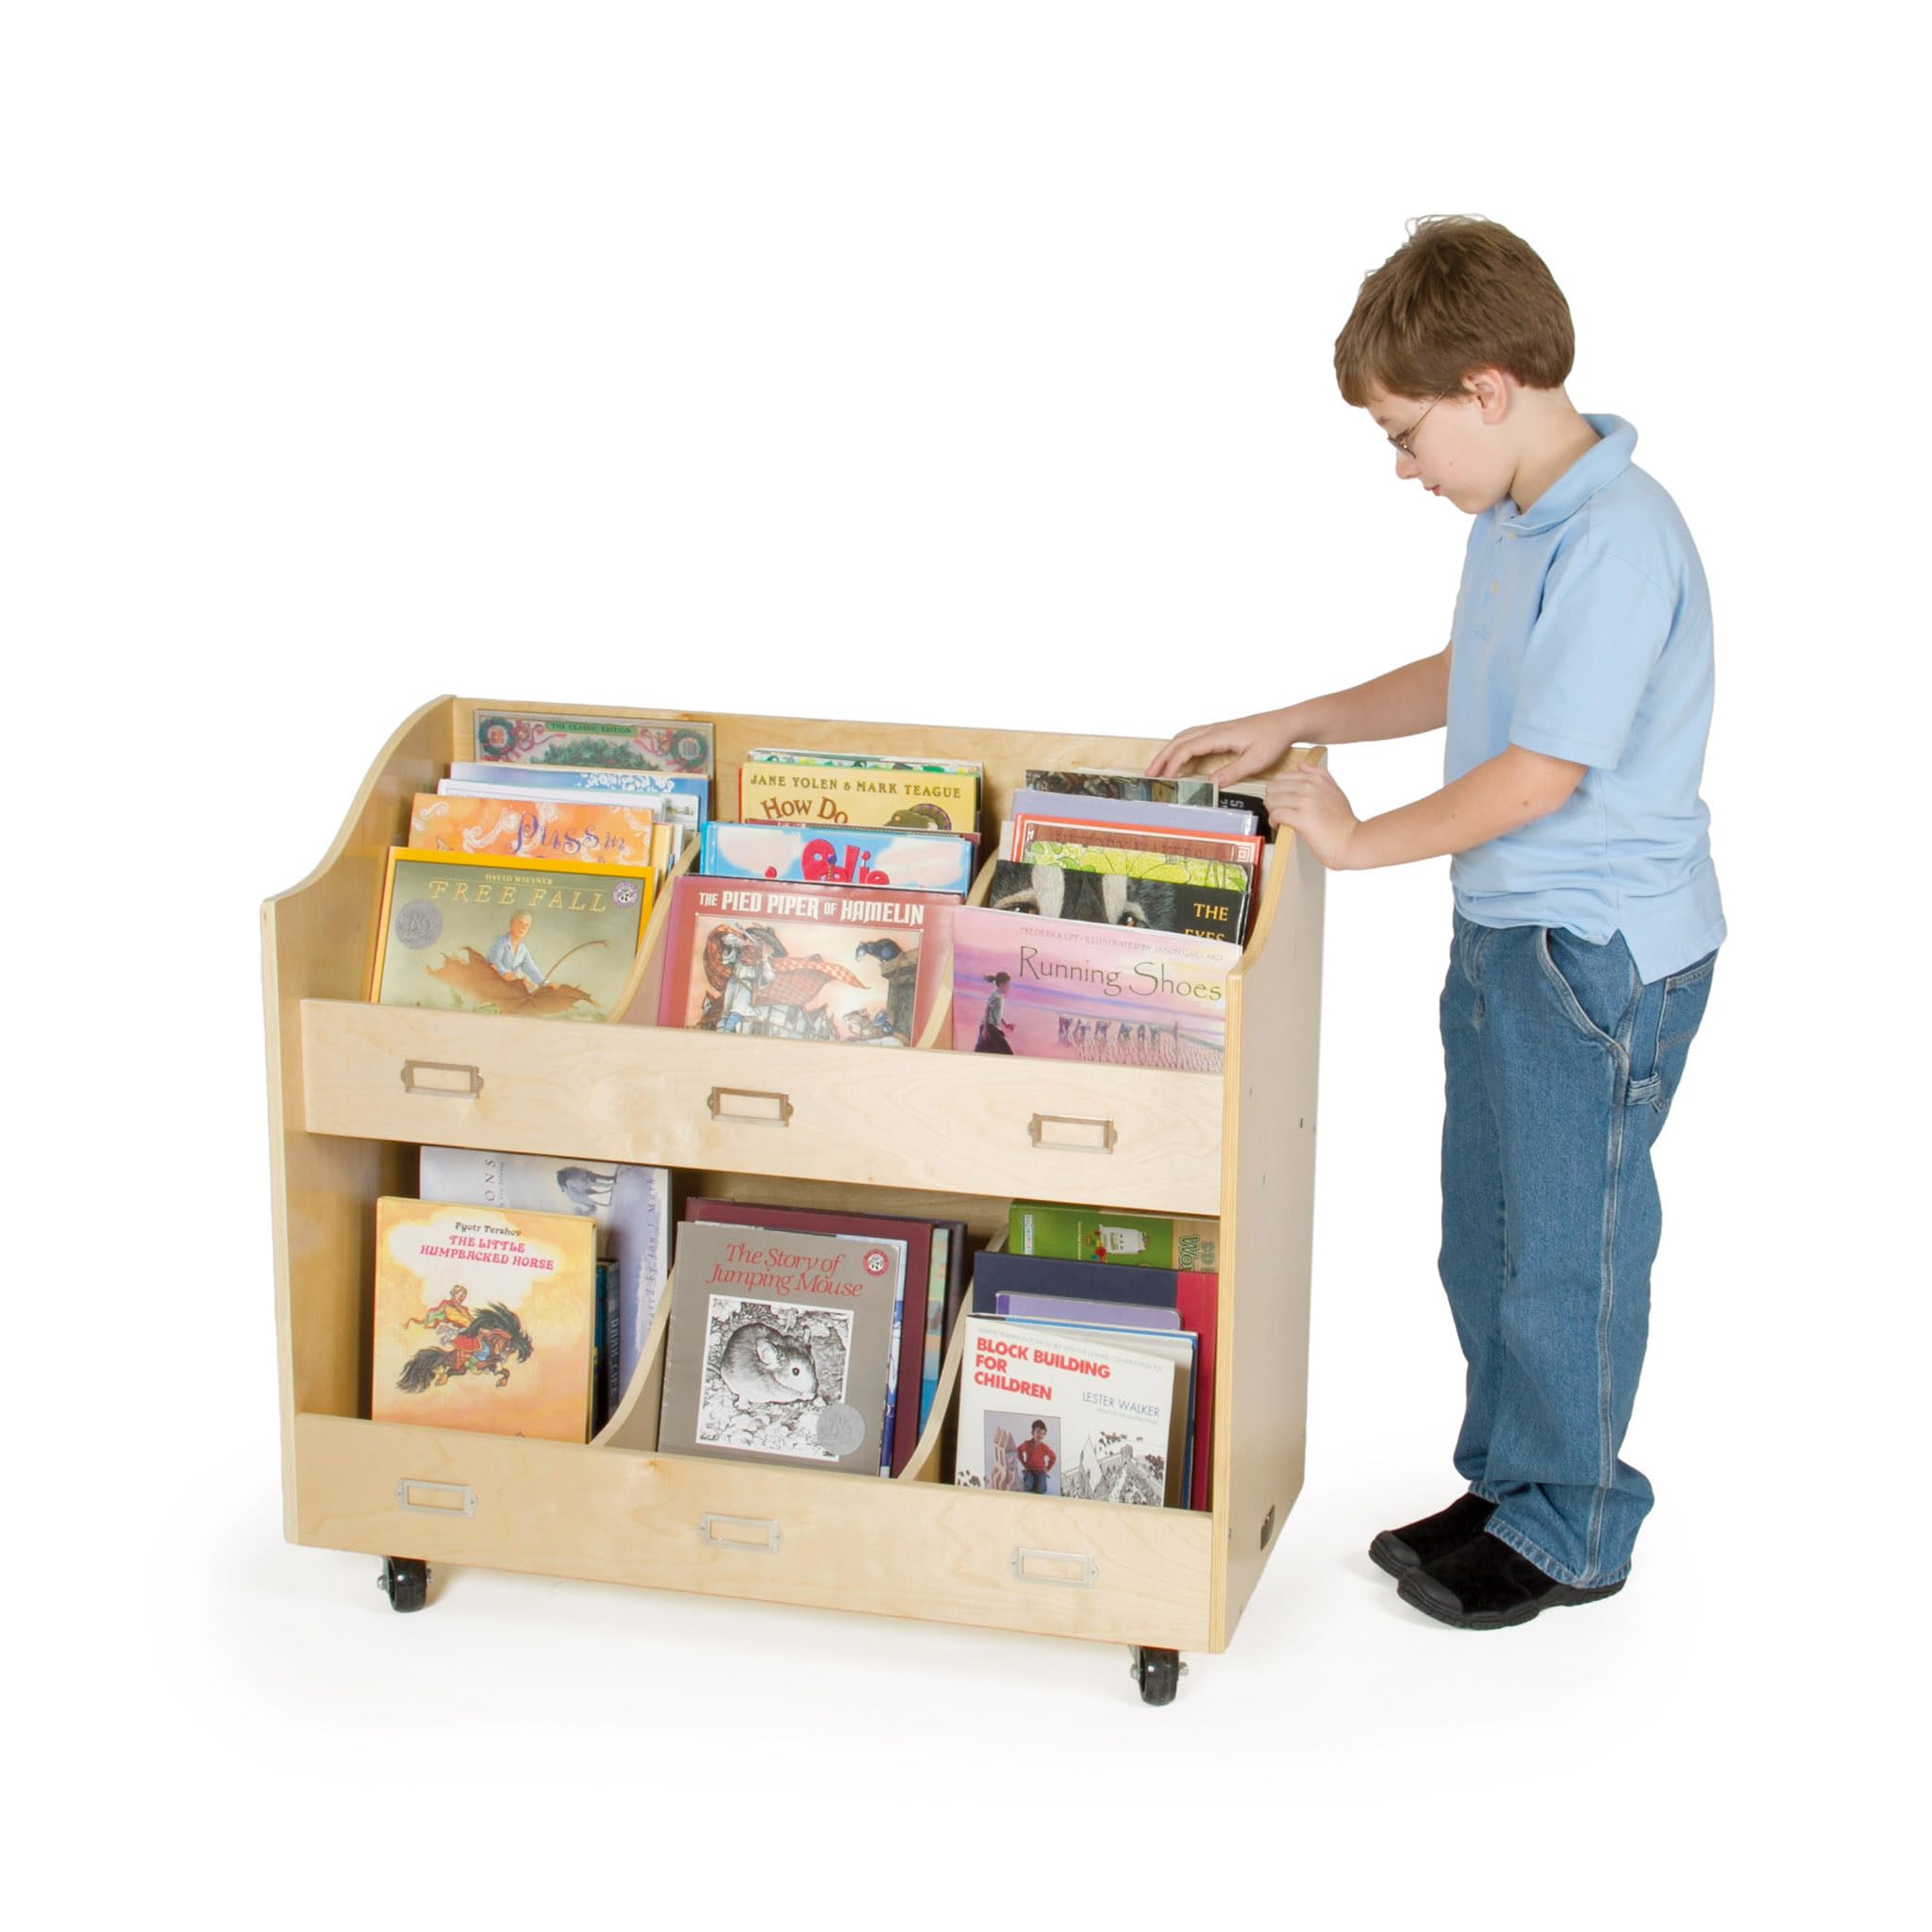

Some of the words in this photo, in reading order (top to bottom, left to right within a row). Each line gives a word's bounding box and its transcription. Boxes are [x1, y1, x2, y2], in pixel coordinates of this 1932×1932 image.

[750, 774, 786, 788] JANE
[792, 776, 838, 791] YOLEN
[857, 781, 898, 794] MARK
[904, 784, 961, 799] TEAGUE
[760, 796, 813, 821] How
[817, 796, 849, 824] Do
[485, 874, 512, 883] DAVID
[514, 875, 554, 885] WIESNER
[428, 880, 517, 906] FREE
[528, 889, 607, 912] FALL
[699, 891, 718, 907] THE
[722, 890, 762, 912] PIED
[767, 893, 819, 921] PIPER
[824, 902, 838, 916] OF
[840, 900, 924, 926] HAMELIN
[1193, 903, 1229, 922] THE
[1020, 945, 1122, 997] Running
[1129, 961, 1222, 1001] Shoes
[455, 1222, 482, 1233] Pyotr
[420, 1245, 509, 1265] HUMPBACKED
[512, 1256, 554, 1271] HORSE
[449, 1235, 475, 1247] THE
[478, 1239, 525, 1254] LITTLE
[726, 1242, 763, 1262] The
[765, 1248, 819, 1272] Story
[820, 1253, 846, 1278] of
[706, 1262, 794, 1296] Jumping
[795, 1273, 863, 1297] Mouse
[975, 1355, 1008, 1374] FOR
[976, 1337, 1028, 1361] BLOCK
[1033, 1349, 1111, 1379] BUILDING
[974, 1371, 1053, 1401] CHILDREN
[1082, 1391, 1115, 1407] LESTER
[1118, 1400, 1160, 1420] WALKER
